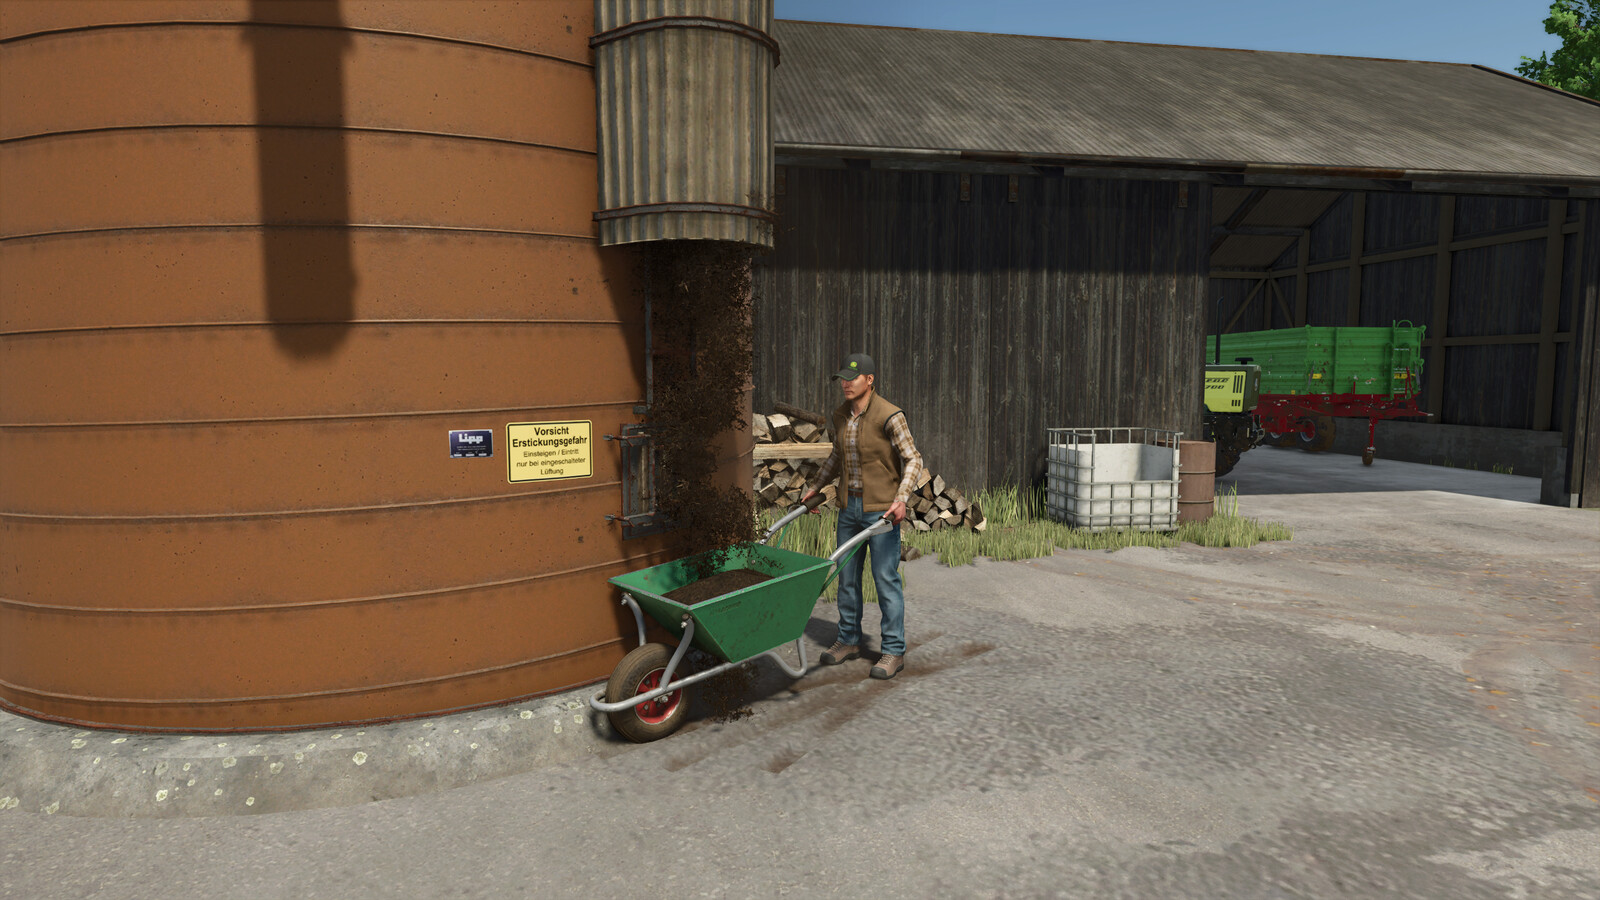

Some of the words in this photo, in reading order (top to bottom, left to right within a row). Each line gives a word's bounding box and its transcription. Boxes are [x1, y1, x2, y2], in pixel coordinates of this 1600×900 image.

[534, 426, 569, 436] Vorsicht
[512, 436, 588, 448] Erstickungsgefahr
[541, 458, 586, 466] eingeschalteter
[540, 468, 564, 476] Lüftung
